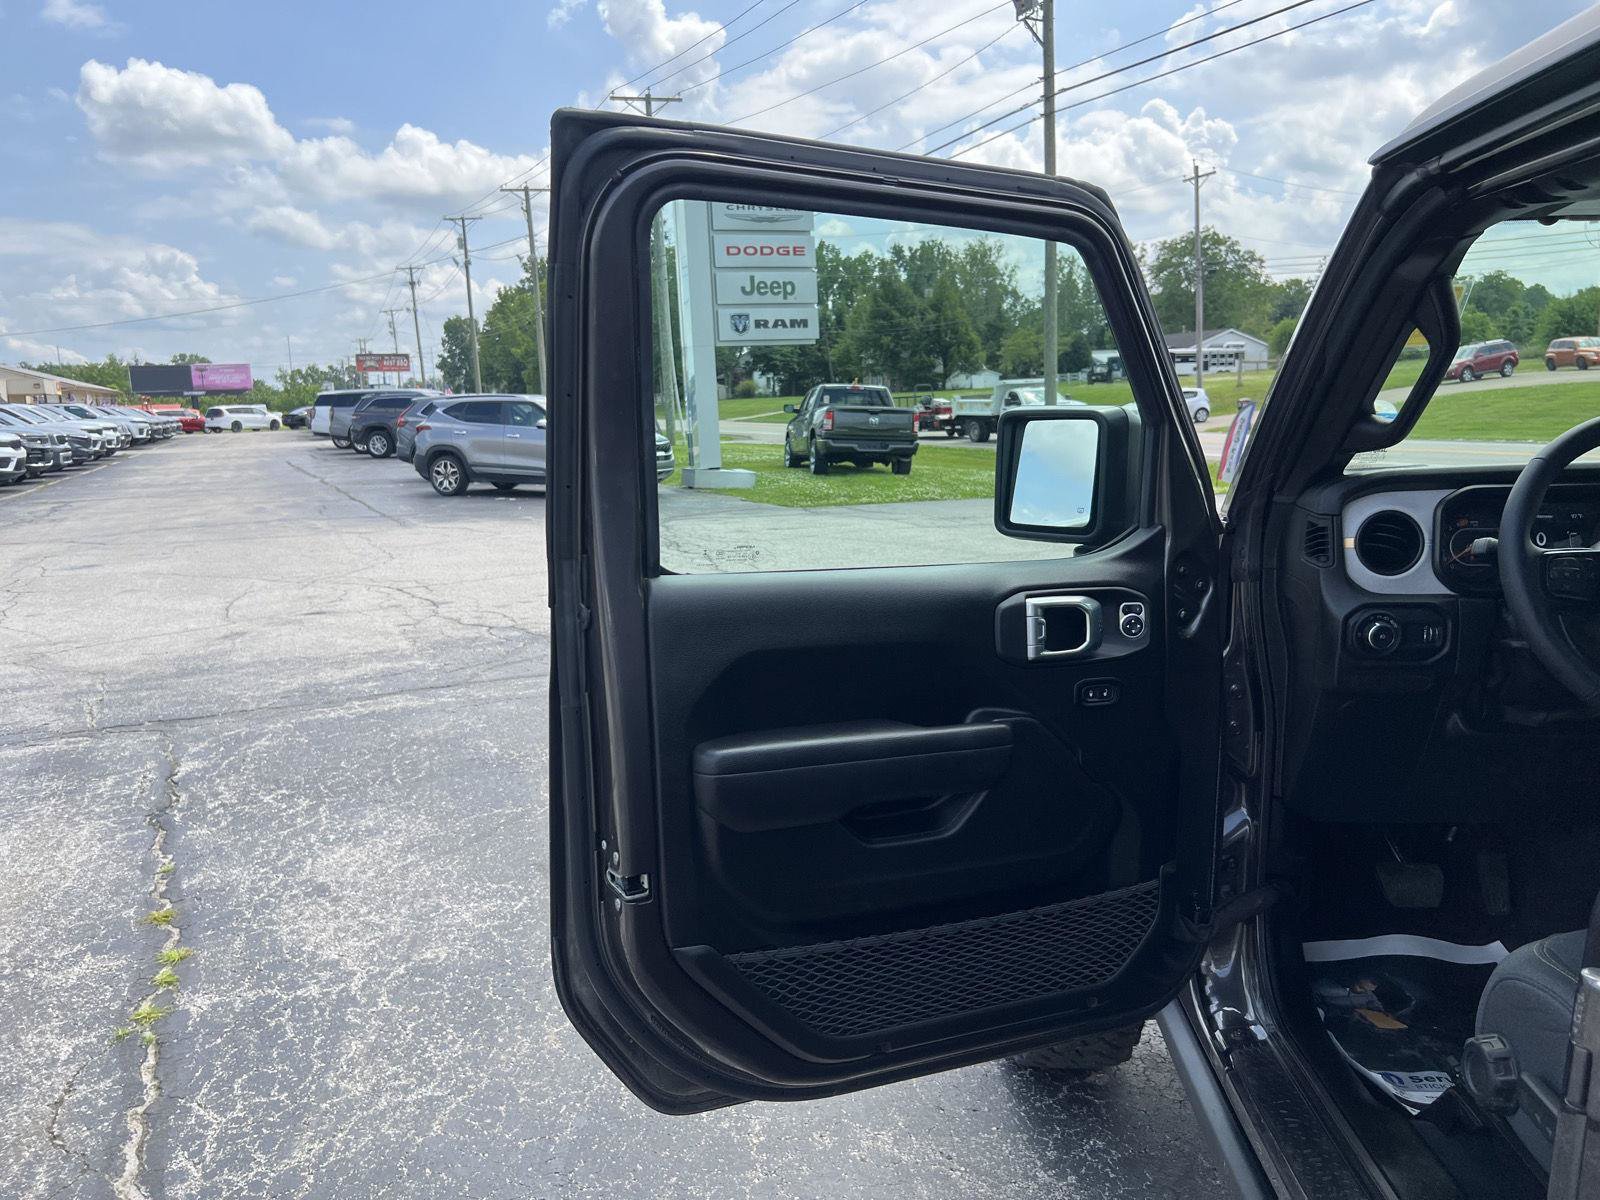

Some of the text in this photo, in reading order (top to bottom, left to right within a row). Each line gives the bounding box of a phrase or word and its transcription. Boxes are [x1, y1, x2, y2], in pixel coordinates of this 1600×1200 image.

[726, 245, 806, 256] DODGE
[740, 275, 796, 300] Jeep
[754, 318, 809, 329] RAM
